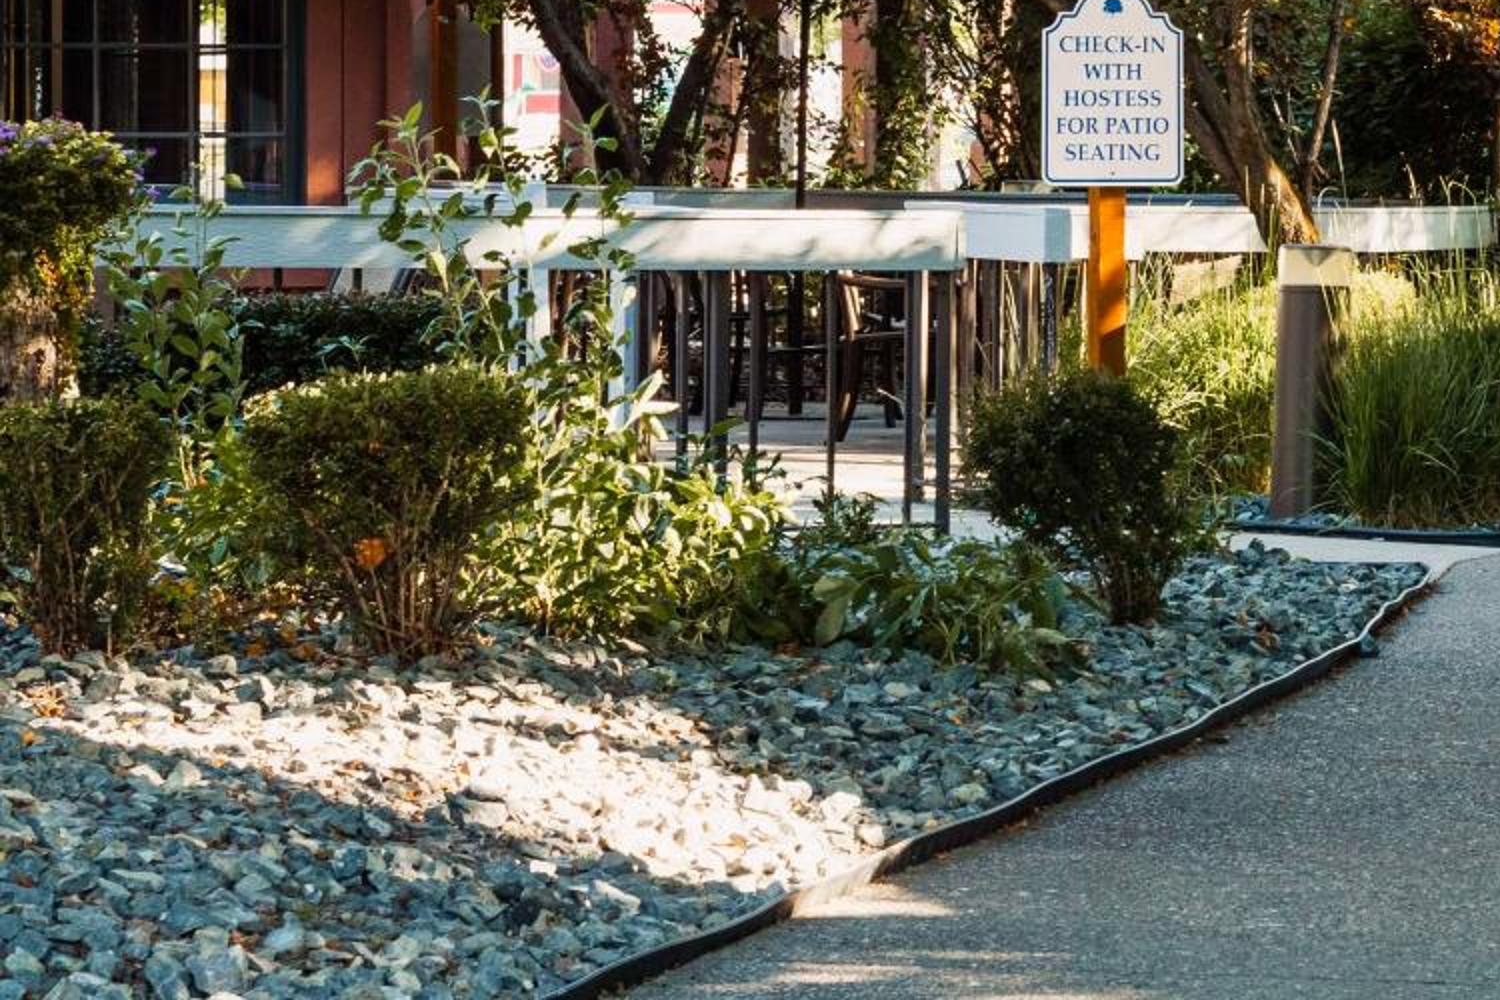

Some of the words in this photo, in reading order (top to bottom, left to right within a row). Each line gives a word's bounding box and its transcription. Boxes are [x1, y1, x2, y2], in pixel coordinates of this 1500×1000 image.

[1059, 35, 1166, 53] CHECK-IN
[1083, 63, 1142, 80] WITH
[1064, 90, 1162, 107] HOSTESS
[1056, 117, 1098, 134] FOR
[1106, 117, 1169, 134] PATIO
[1065, 144, 1160, 161] SEATING
